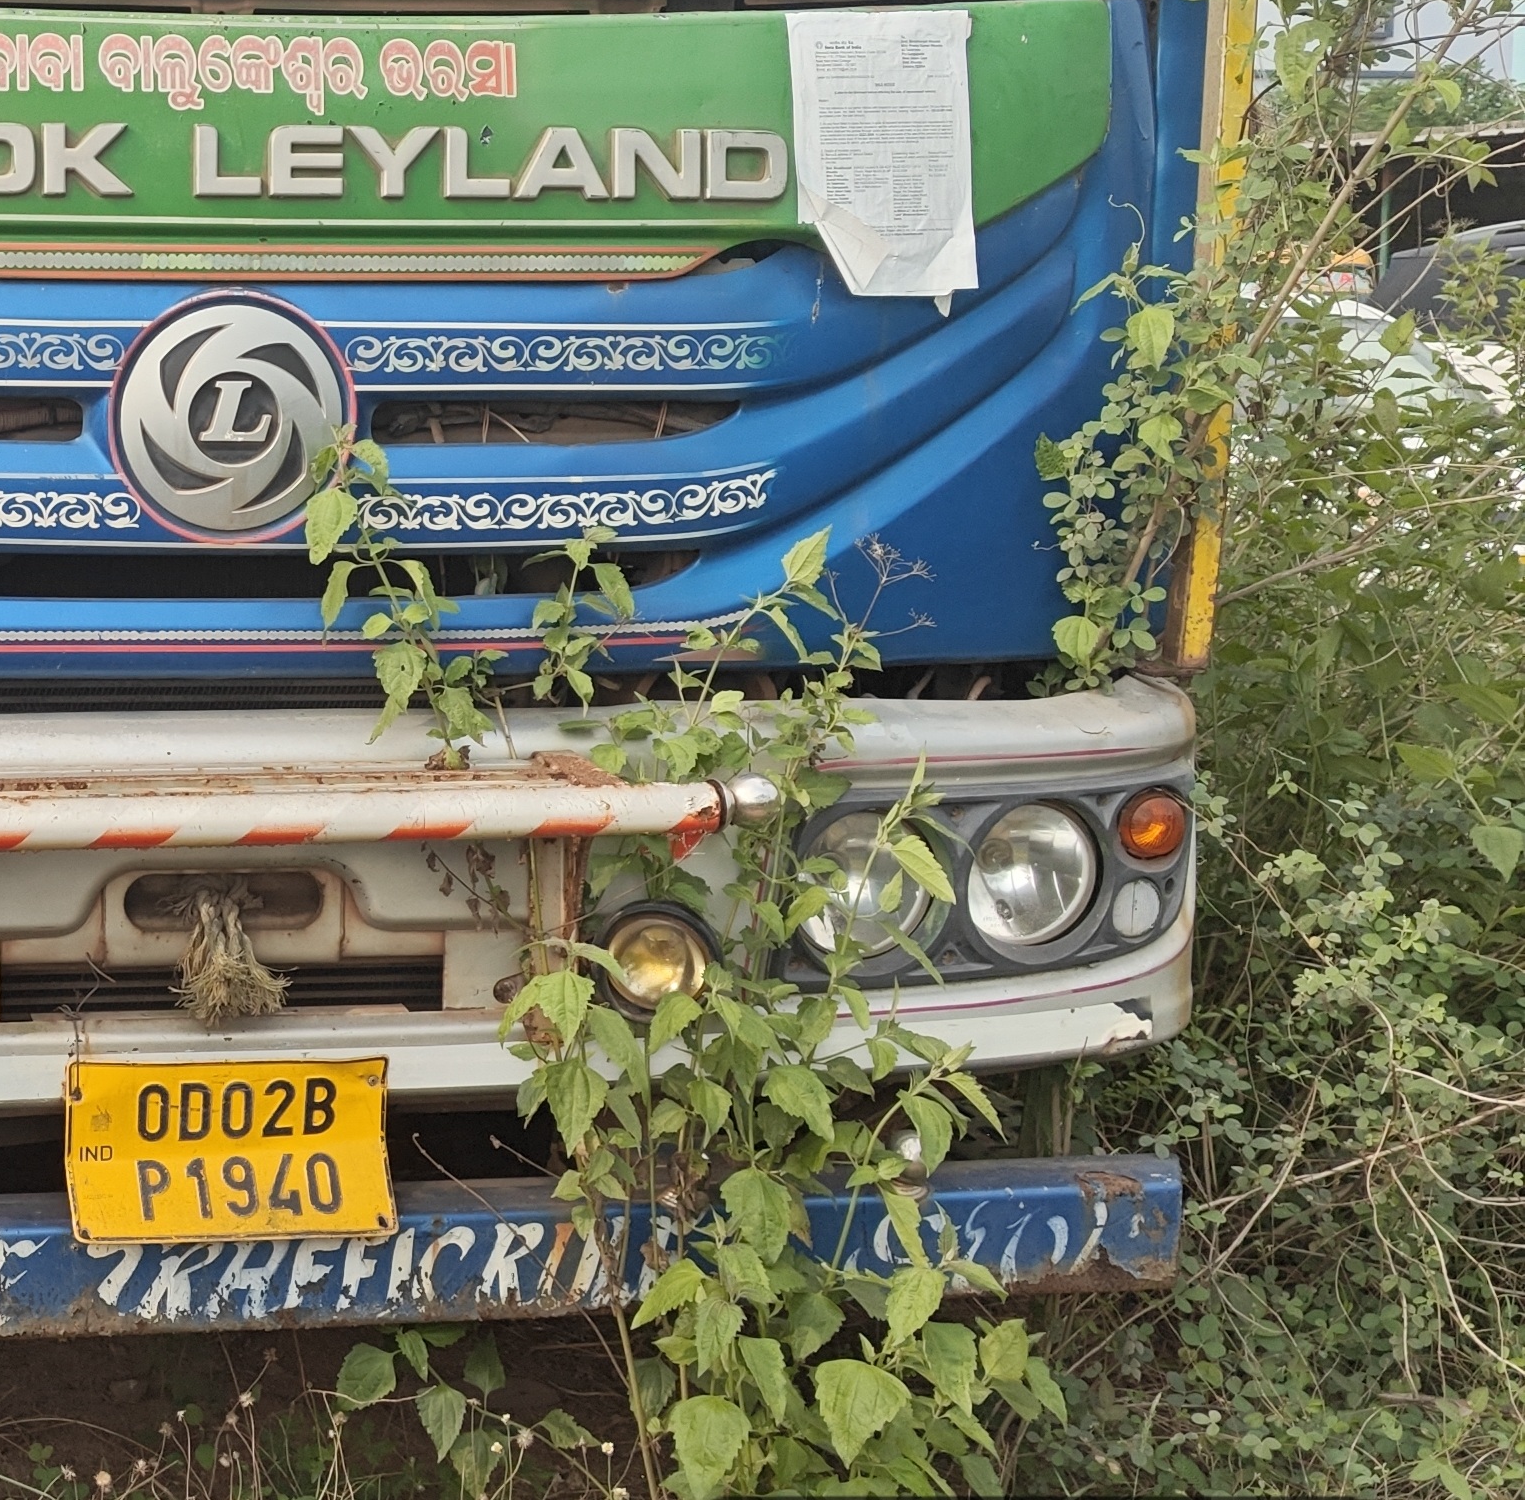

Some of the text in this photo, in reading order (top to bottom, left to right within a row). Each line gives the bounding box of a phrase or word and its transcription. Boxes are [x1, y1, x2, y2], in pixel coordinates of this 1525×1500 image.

[379, 37, 518, 102] ଭରସା
[193, 123, 789, 203] LEYLAND
[198, 380, 272, 442] L
[137, 1077, 337, 1142] OD02B
[79, 1145, 113, 1162] IND
[136, 1152, 343, 1221] P1940
